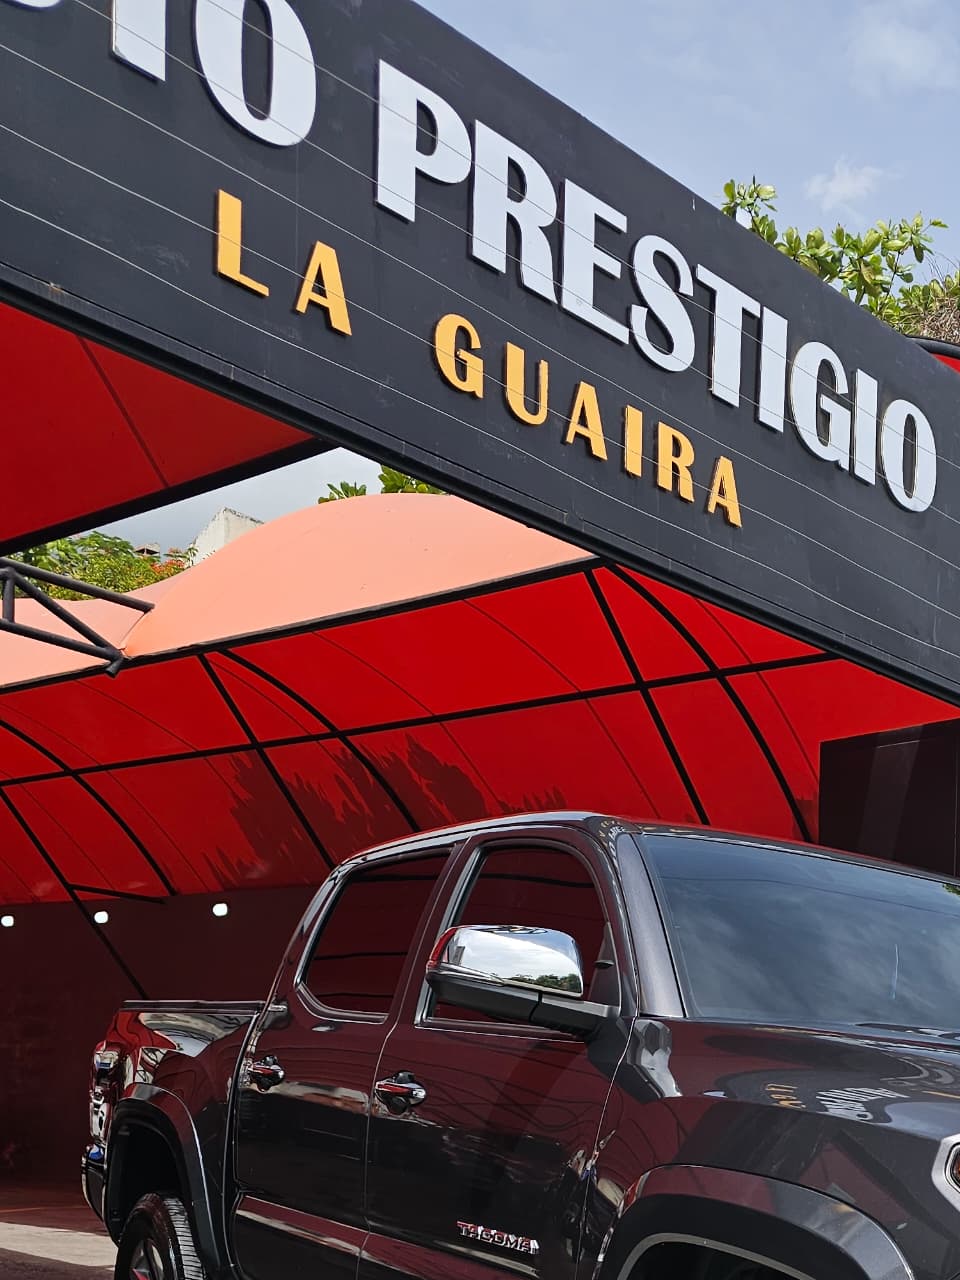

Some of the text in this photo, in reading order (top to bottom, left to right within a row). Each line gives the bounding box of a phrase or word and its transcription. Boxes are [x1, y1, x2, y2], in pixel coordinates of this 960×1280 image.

[217, 190, 742, 528] LA GUAIRA
[377, 59, 938, 513] PRESTIGIO
[457, 1220, 540, 1255] TACOMA
